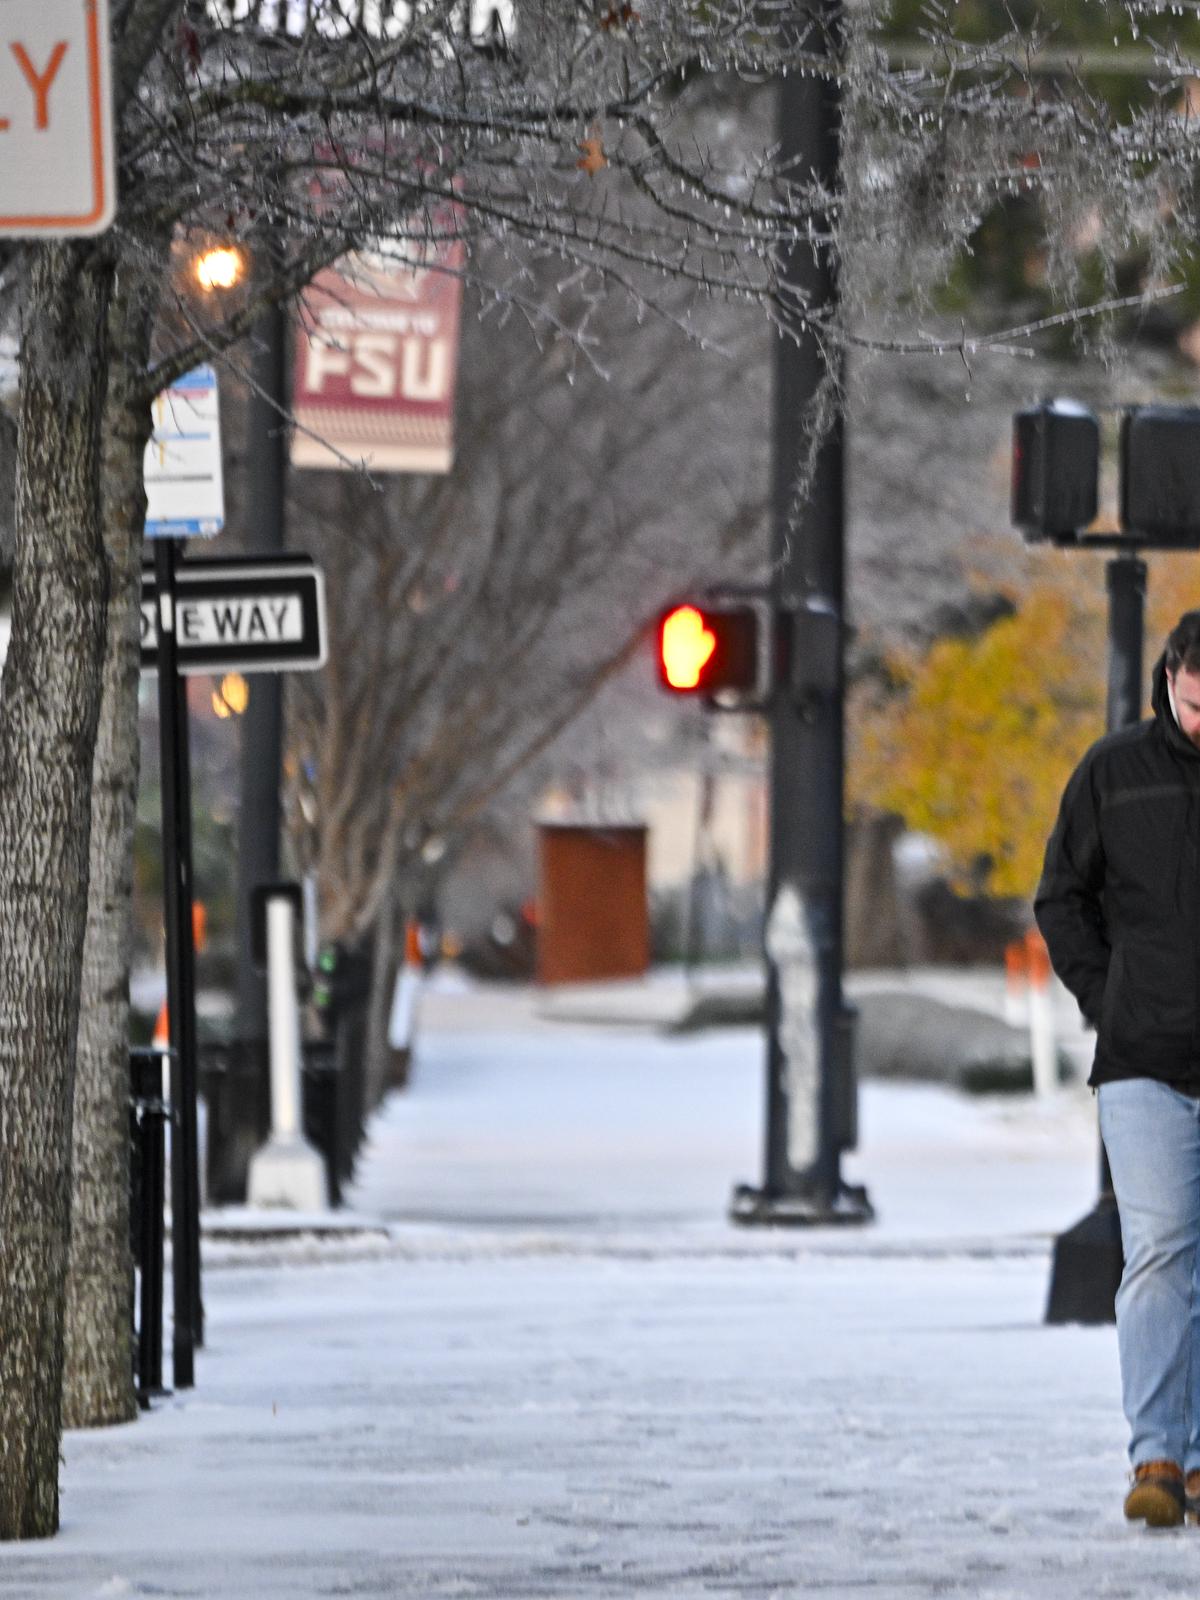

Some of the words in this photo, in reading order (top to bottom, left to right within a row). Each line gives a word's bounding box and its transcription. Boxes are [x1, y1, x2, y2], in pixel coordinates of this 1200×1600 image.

[0, 40, 69, 132] Y
[306, 329, 446, 399] FSU
[213, 601, 288, 638] WAY
